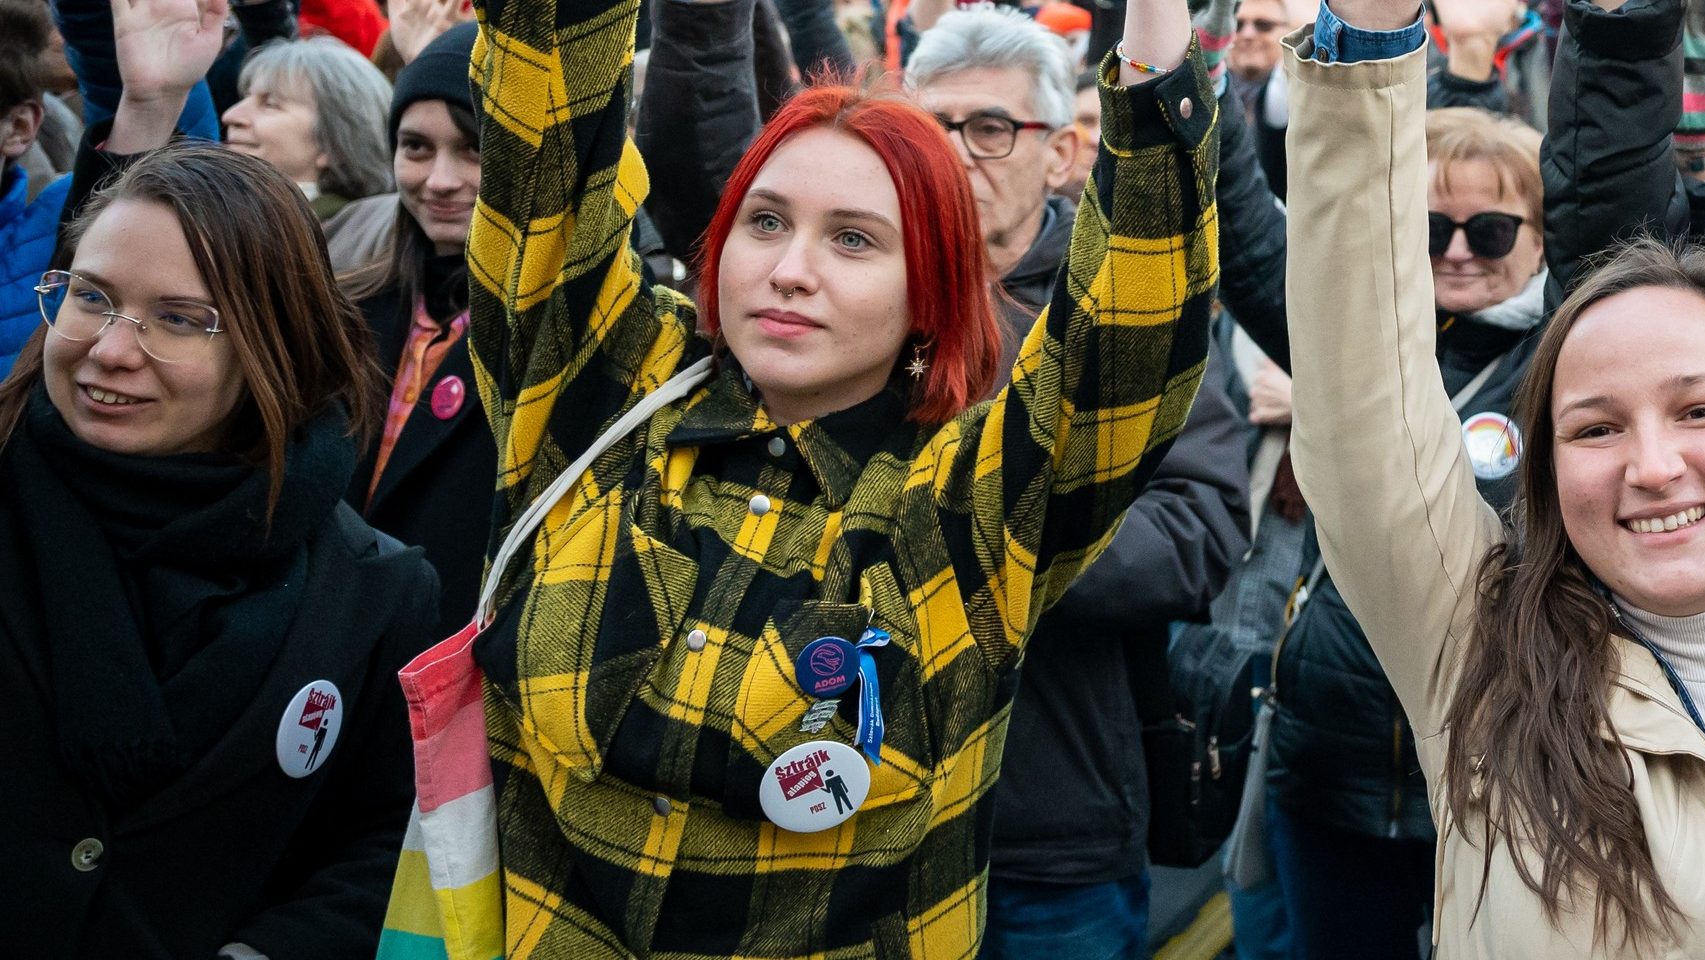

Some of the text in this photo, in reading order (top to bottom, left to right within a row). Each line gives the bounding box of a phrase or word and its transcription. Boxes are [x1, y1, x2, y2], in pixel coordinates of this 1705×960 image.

[814, 674, 847, 690] ADOM
[308, 688, 336, 710] Sztrájk
[774, 749, 830, 780] Sztrájk
